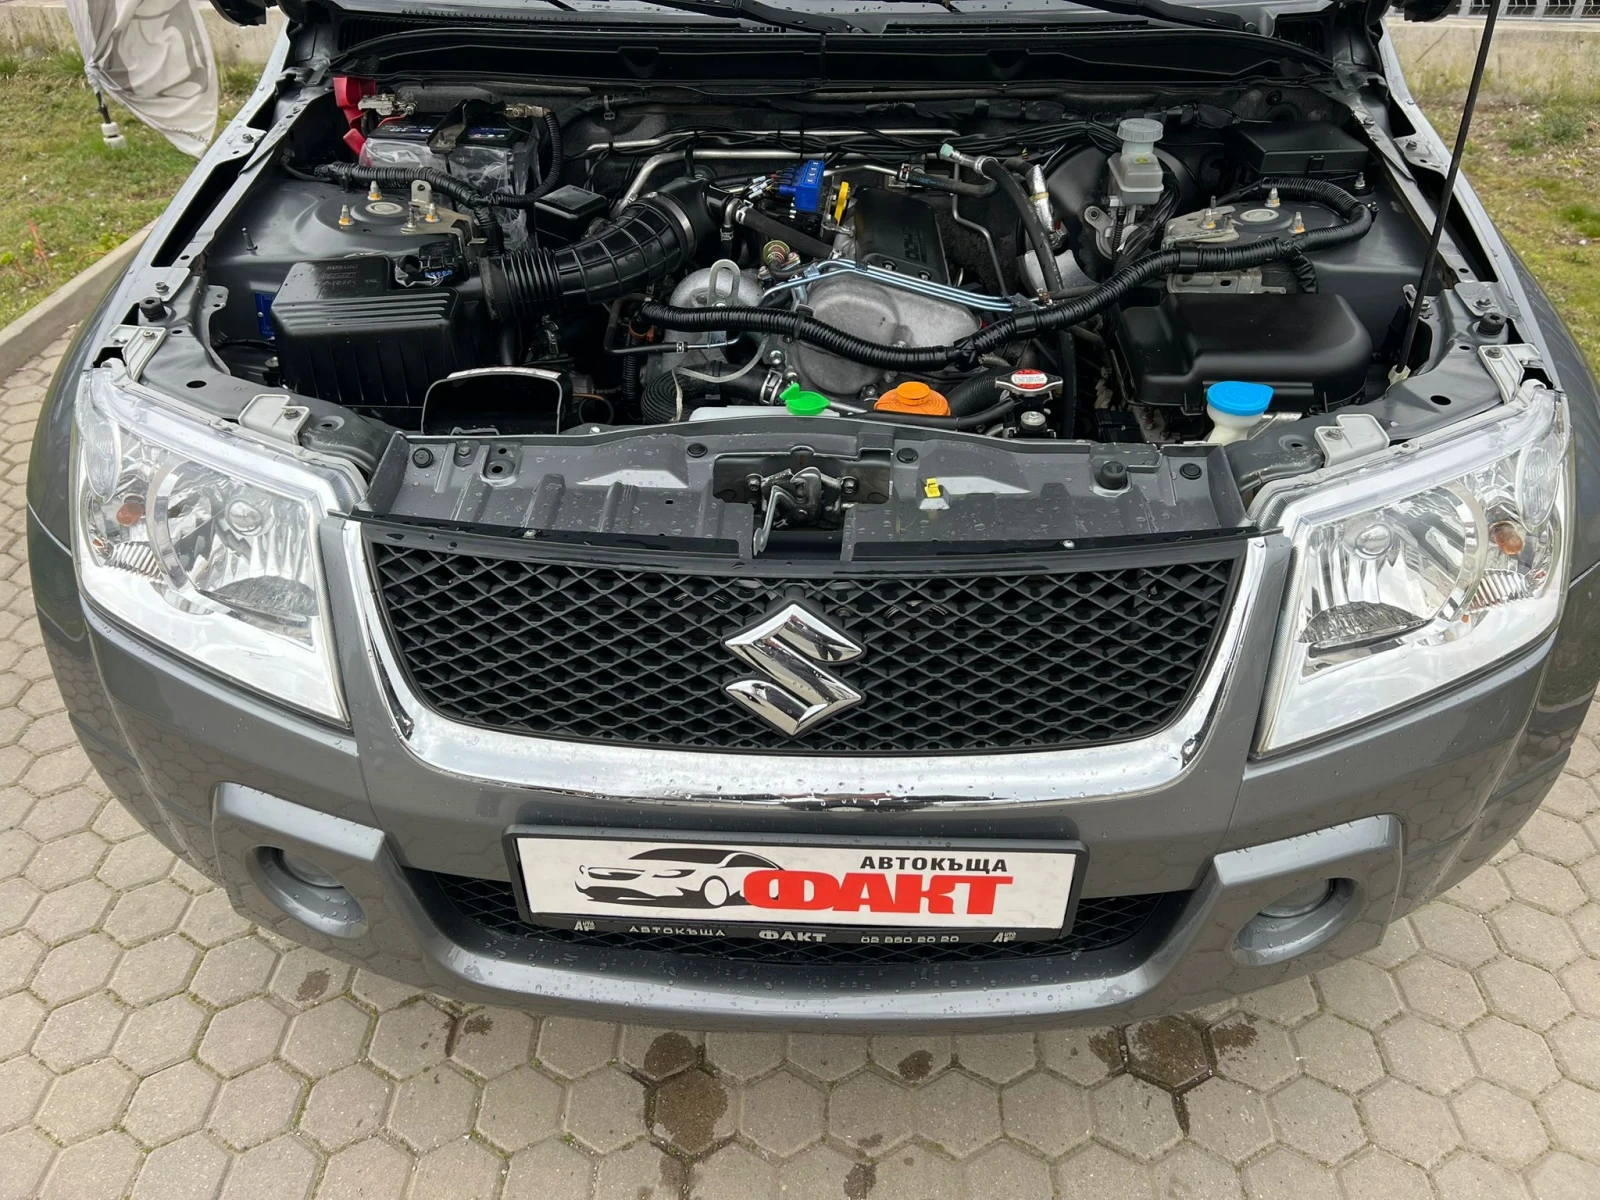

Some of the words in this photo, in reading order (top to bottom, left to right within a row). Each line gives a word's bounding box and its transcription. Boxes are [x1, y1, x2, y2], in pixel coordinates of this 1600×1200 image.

[860, 856, 1007, 874] АВТОКЪЩА
[743, 869, 1013, 915] ФАКТ
[758, 930, 826, 943] ФАКТ
